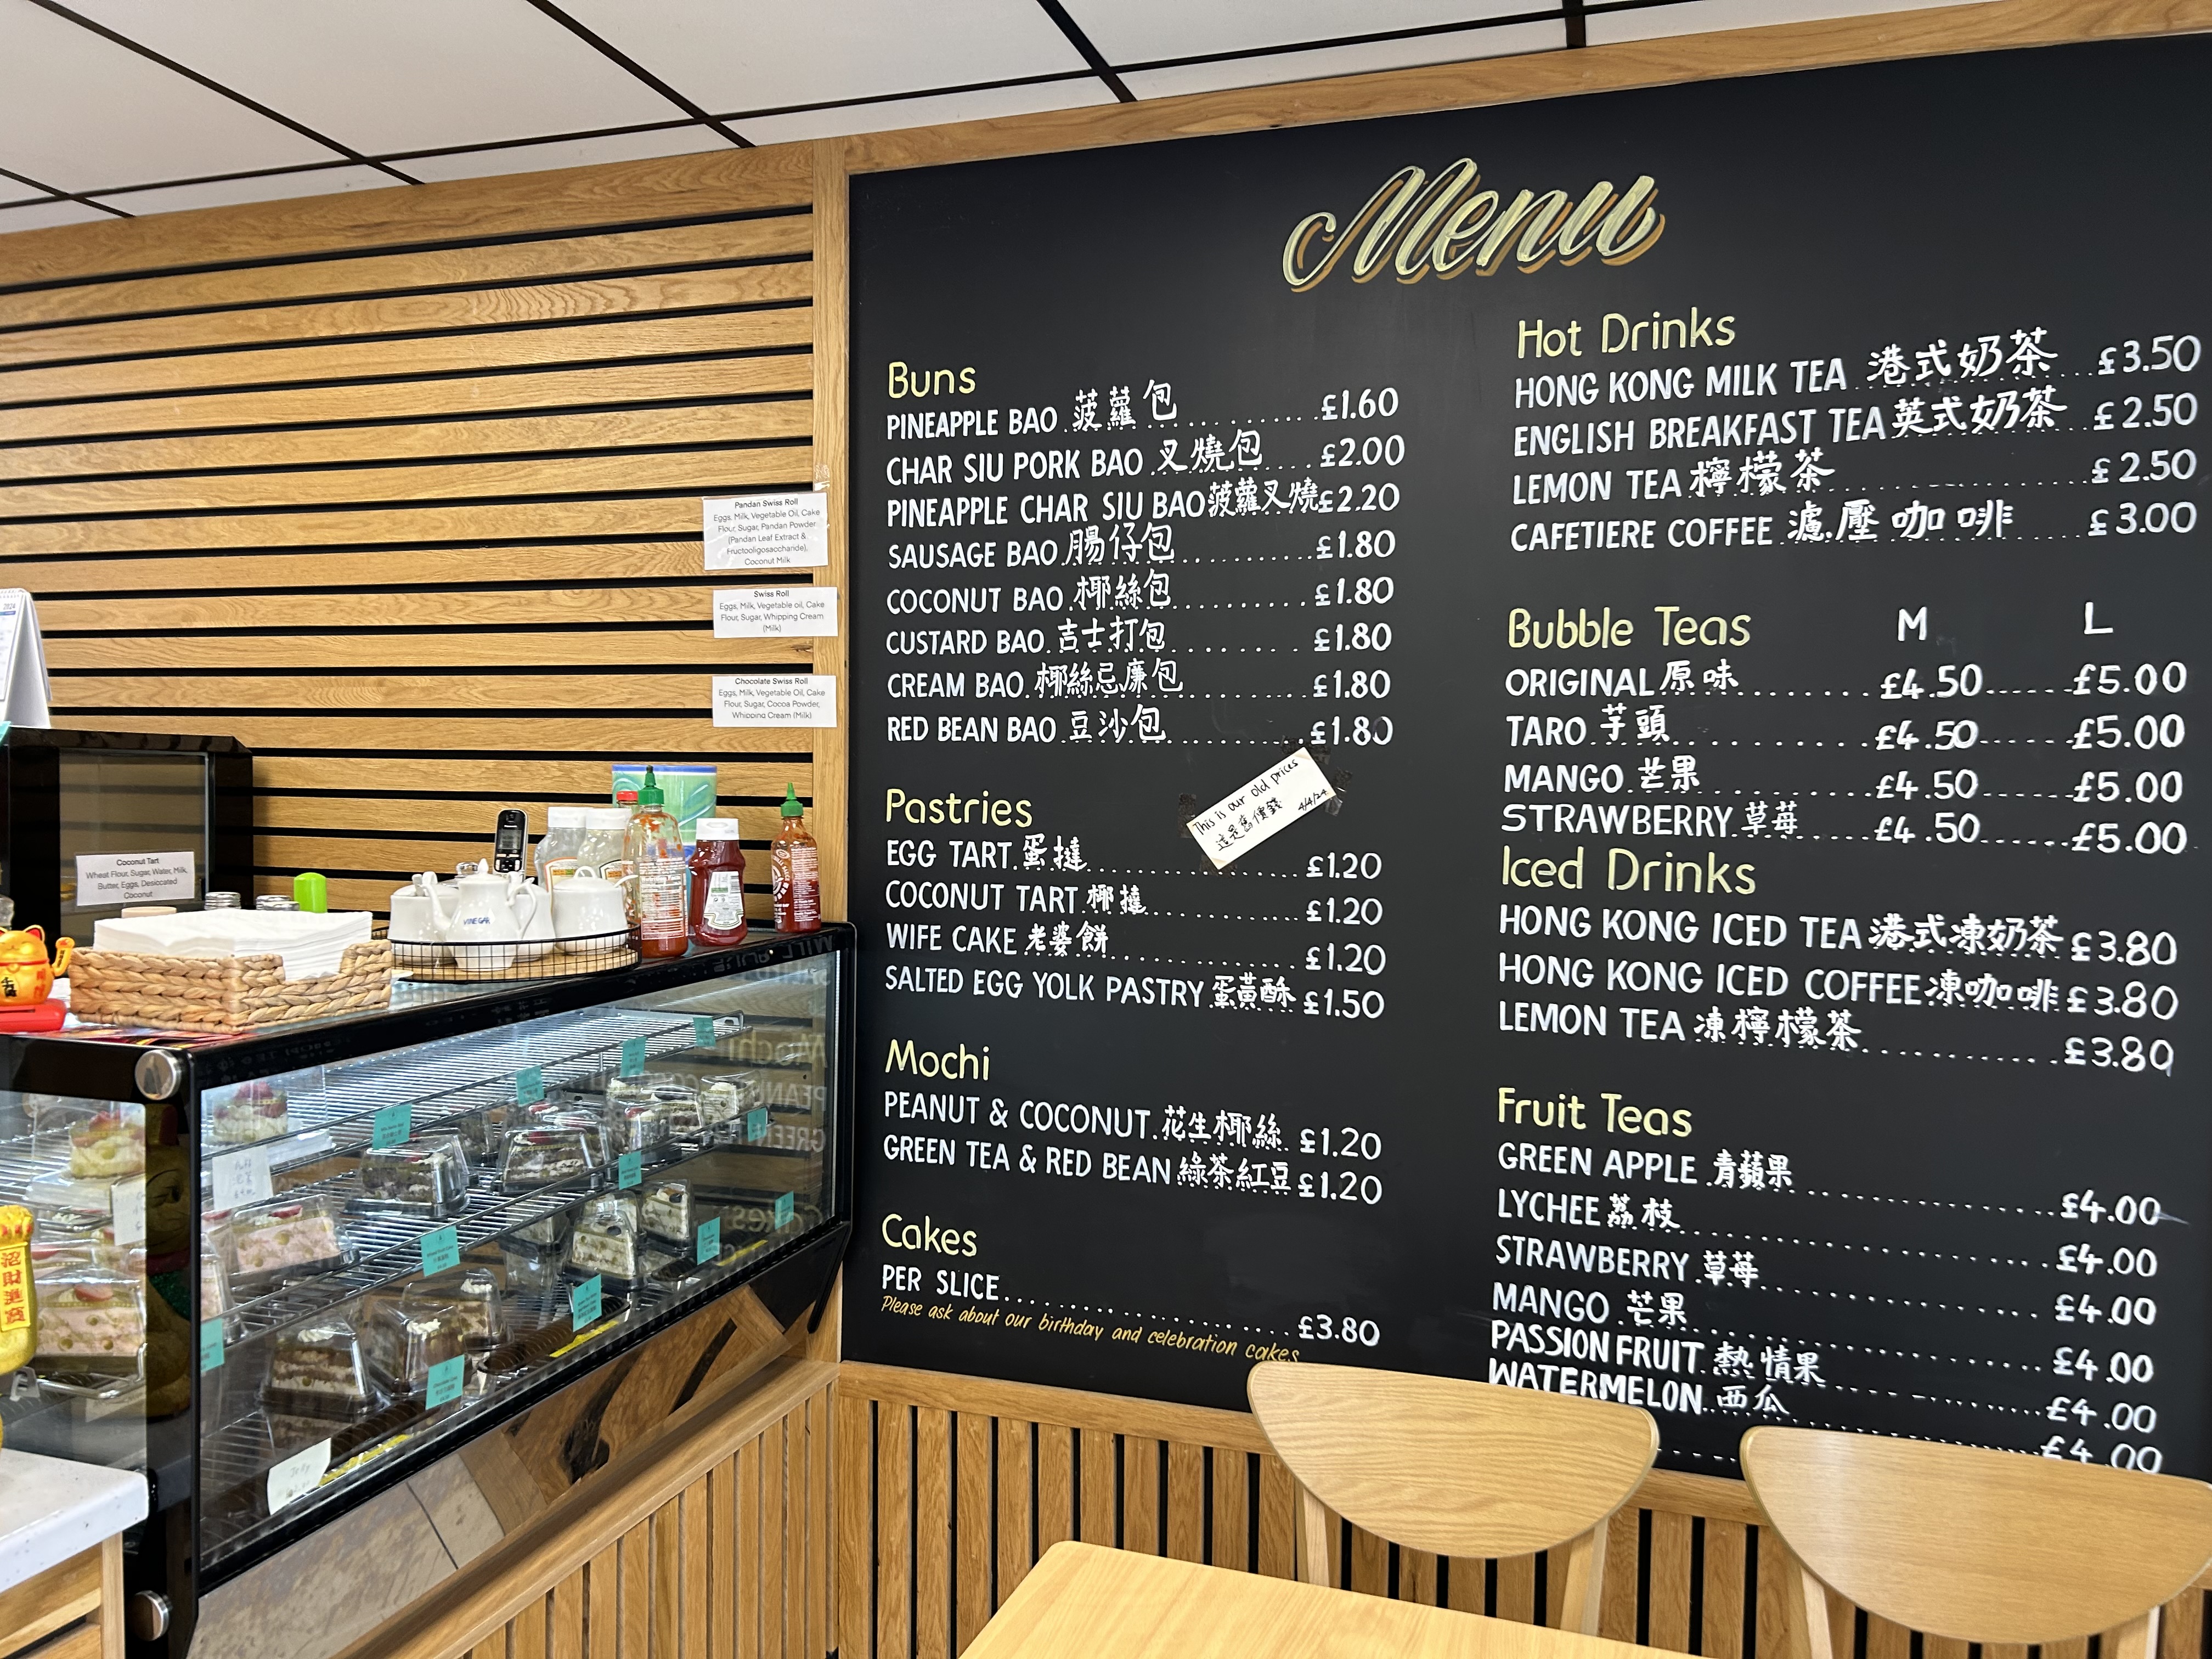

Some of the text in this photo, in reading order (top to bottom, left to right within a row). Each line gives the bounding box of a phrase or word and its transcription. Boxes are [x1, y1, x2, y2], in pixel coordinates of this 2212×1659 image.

[1282, 157, 1666, 293] Menu
[1517, 307, 1735, 359] Hot Drinks
[888, 362, 976, 399] Buns
[1515, 326, 2201, 409] HONG KONG MILK TEA 港式奶茶 £3.50
[887, 379, 1399, 440] PINEAPPLE BAO 菠蘿包 £1.60
[887, 428, 1405, 486] CHAR SIU PORK BAO 叉燒包 £2.00
[1513, 447, 2197, 505] LEMON TEA 檸檬茶 £2.50
[728, 535, 756, 544] (Pandan
[751, 511, 786, 520] Vegetable
[744, 557, 775, 566] Coconut
[757, 602, 792, 610] Vegetable
[1508, 602, 2114, 649] Bubble Teas M L
[1505, 658, 2187, 699] ORIGINAL 原味 £4.50 £5.00
[887, 703, 1393, 746] RED BEAN BAO 豆沙包 £1.80
[886, 788, 1032, 828] Pastries
[1193, 759, 1298, 835] This is our old prices
[1216, 798, 1283, 851] 這是舊價錢
[887, 833, 1382, 879] EGG TART 蛋撻 £1.20
[1502, 845, 1756, 895] Iced Drinks
[463, 917, 490, 925] VINEGAR
[885, 965, 1385, 1019] SALTED EGG YOLK PASTRY 蛋黃酥 £1.50
[1499, 952, 1594, 988] HONG
[1607, 958, 1703, 994] KONG
[1717, 963, 1788, 996] ICED
[1805, 969, 1922, 1006] COFFEE
[2066, 981, 2179, 1020] £3.80
[885, 1039, 989, 1081] Mochi
[885, 1091, 1381, 1160] PEANUT & COCONUT 花生椰絲 £1.20
[1498, 1087, 1692, 1137] Fruit Teas
[882, 1214, 977, 1257] Cakes
[1498, 1188, 2158, 1277] LYCHEE 荔枝 £4.00
[881, 1295, 1300, 1362] Please ask about our birthday and celebration cakes
[882, 1264, 1380, 1346] PER SLICE £3.80
[1487, 1357, 1790, 1415] WATERMELON 西瓜
